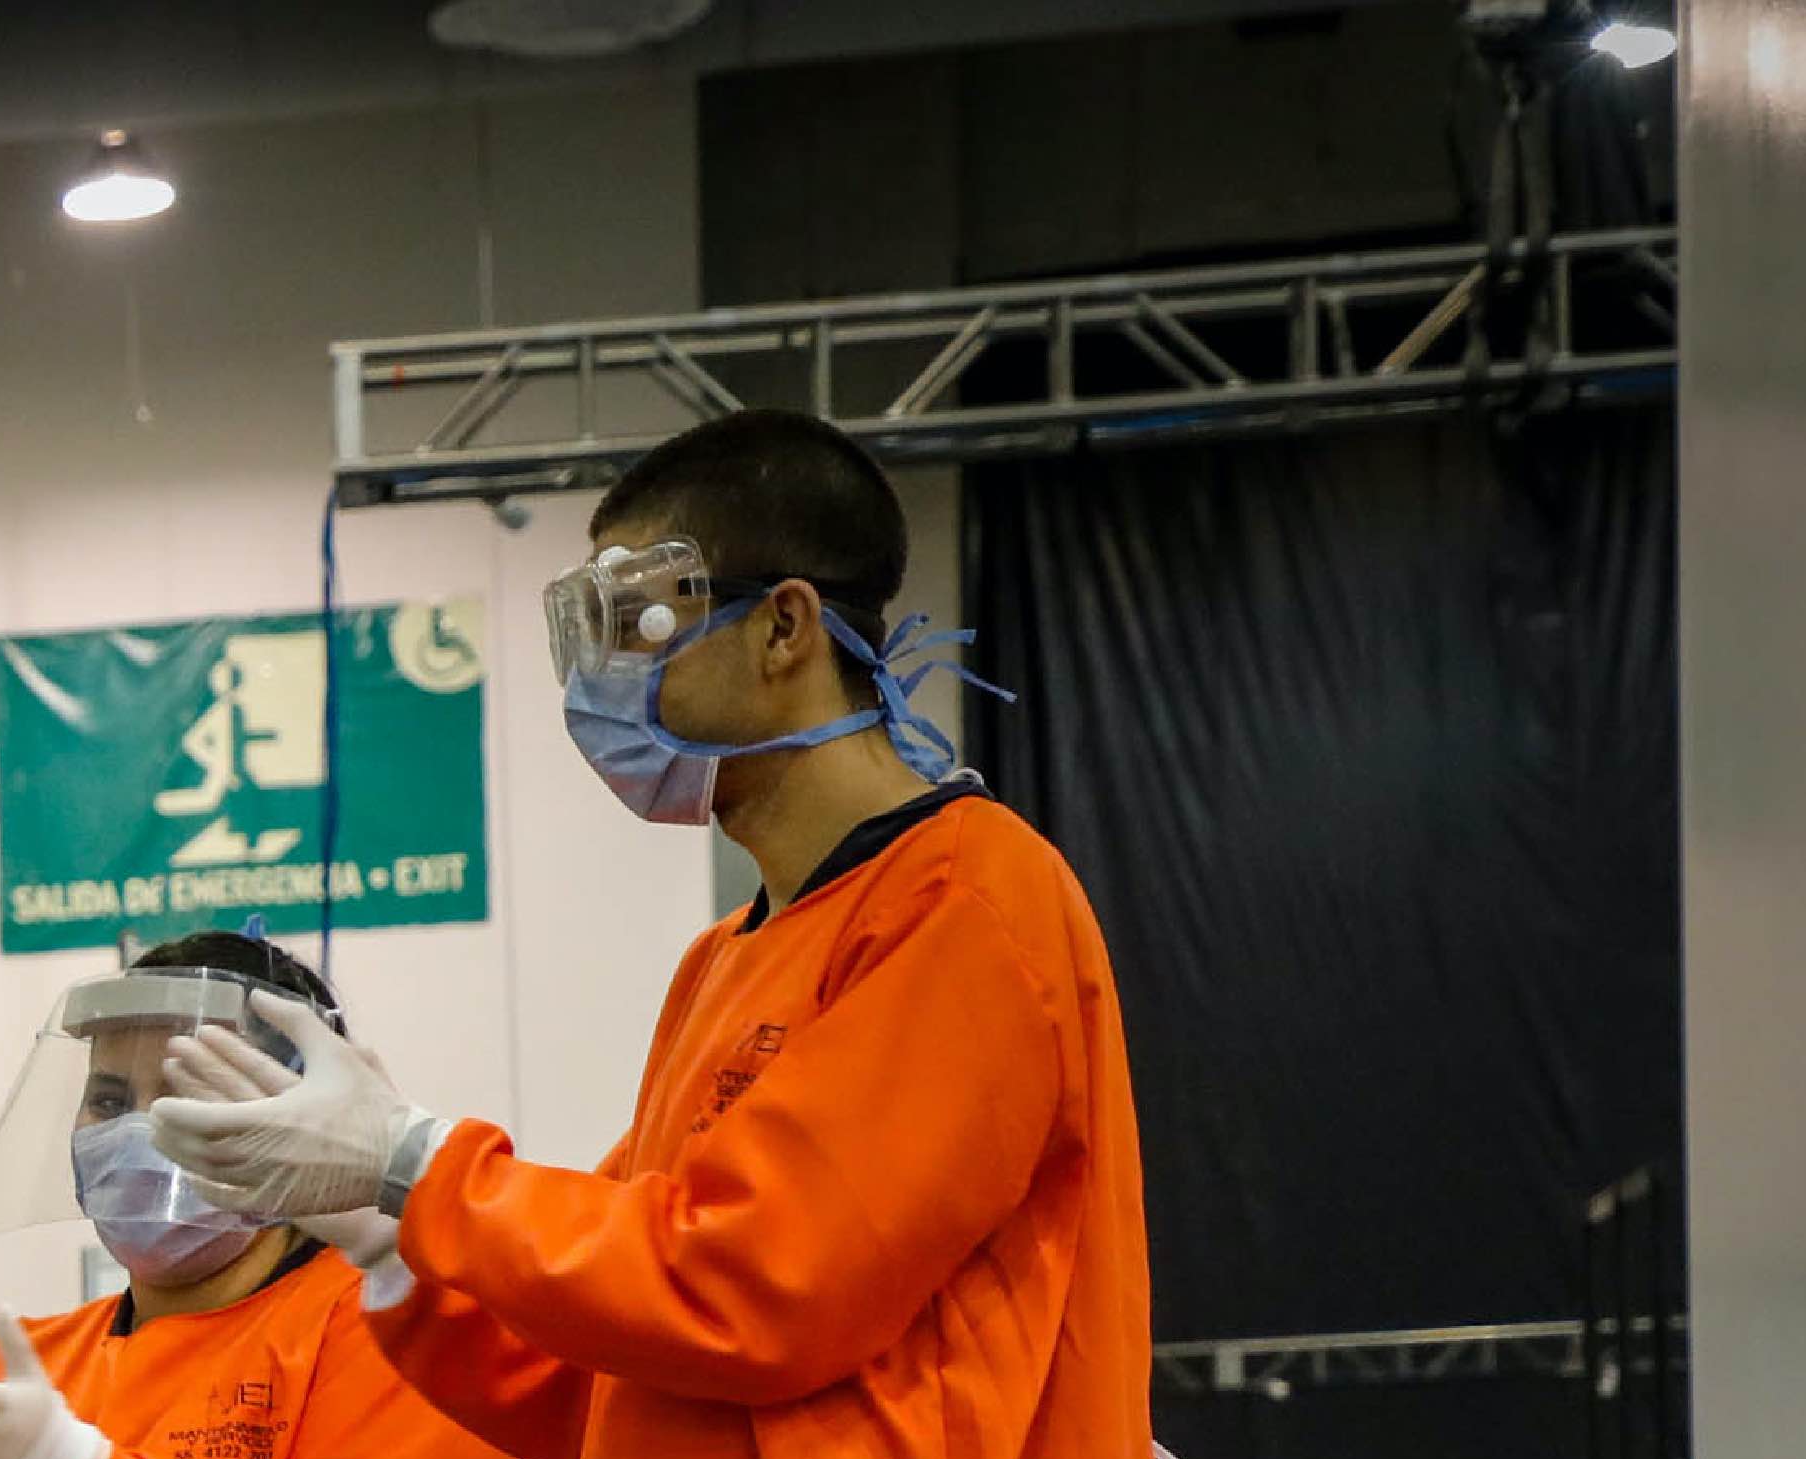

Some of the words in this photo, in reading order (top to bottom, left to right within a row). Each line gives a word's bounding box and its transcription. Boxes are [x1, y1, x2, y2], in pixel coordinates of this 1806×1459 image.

[13, 879, 121, 924] SALIDA
[171, 862, 364, 911] EMERGENCIA
[394, 853, 468, 896] EXIT
